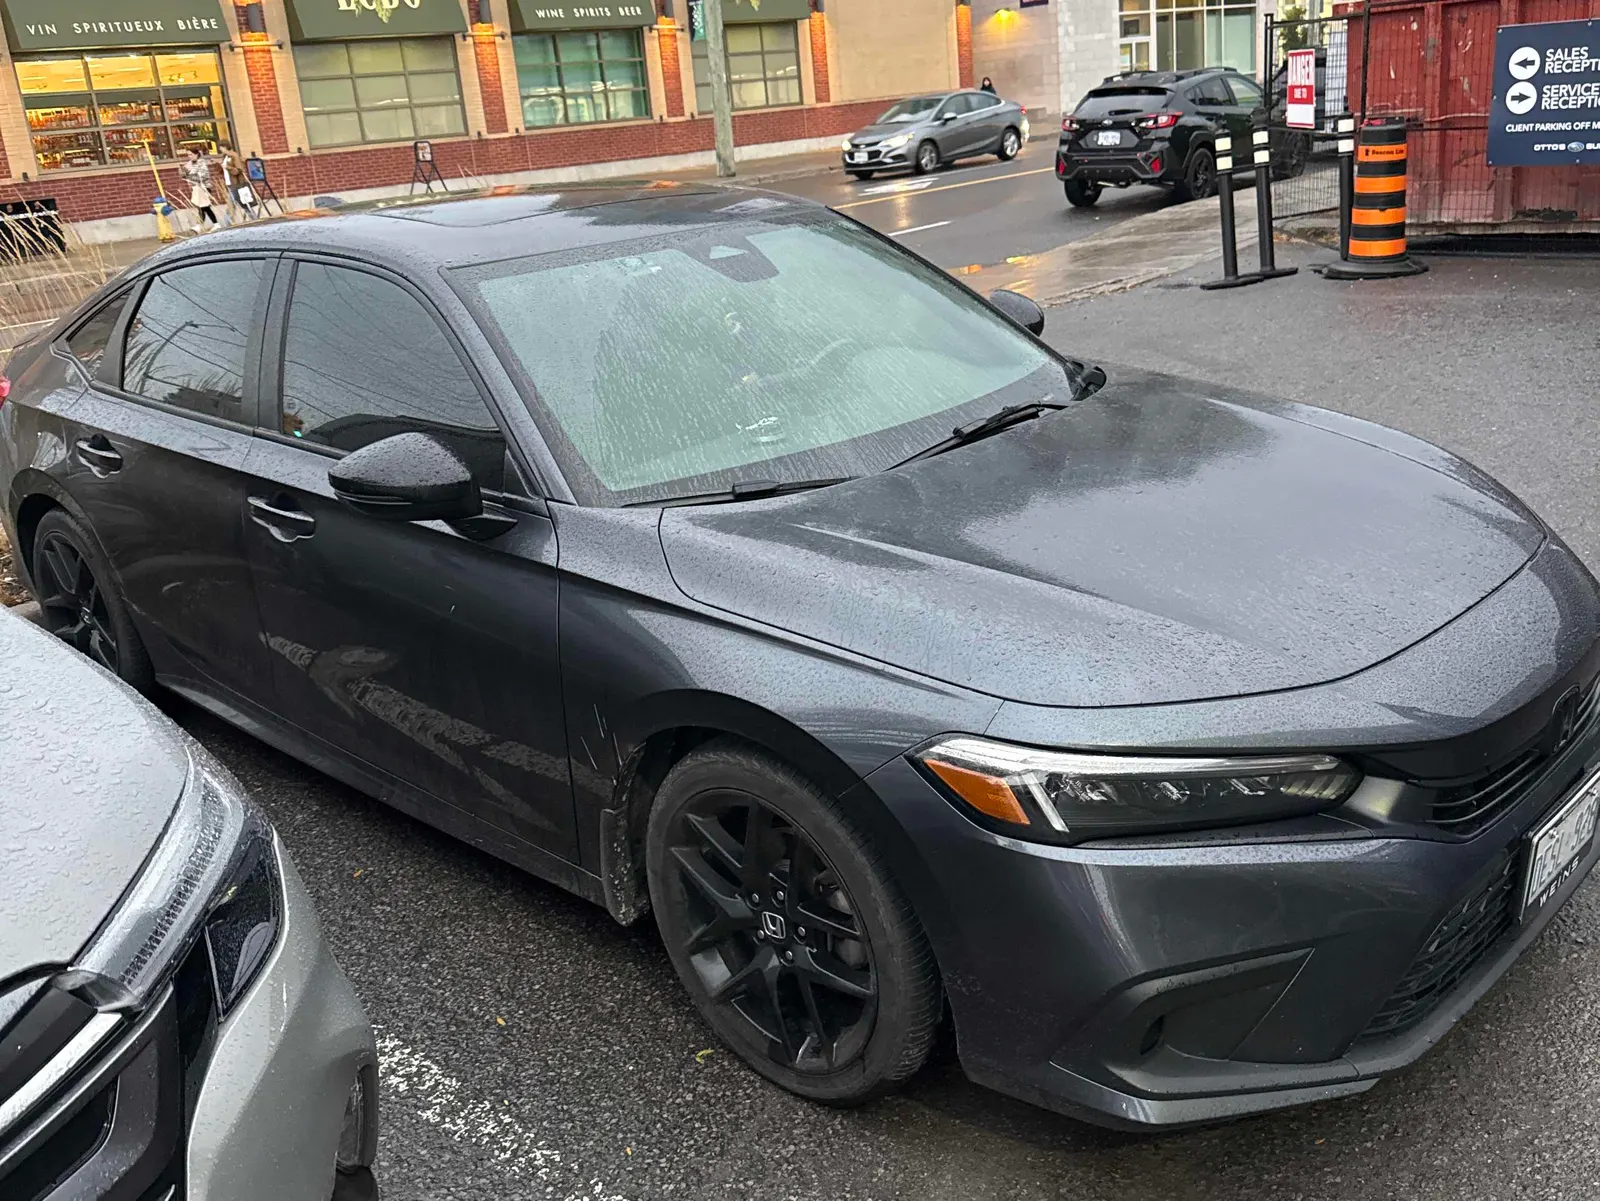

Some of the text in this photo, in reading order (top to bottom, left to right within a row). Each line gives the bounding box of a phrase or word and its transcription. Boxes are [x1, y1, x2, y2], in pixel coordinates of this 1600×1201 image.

[535, 6, 642, 18] WINE SPIRITS BEER
[26, 16, 219, 36] VIN SPIRITUEUX BIÈRE
[1545, 46, 1589, 61] SALES
[1541, 83, 1600, 98] SERVICE
[1505, 123, 1534, 132] CLIENT
[1534, 122, 1572, 131] PARKING
[1573, 121, 1591, 130] OFF
[1539, 855, 1579, 908] WEINS
